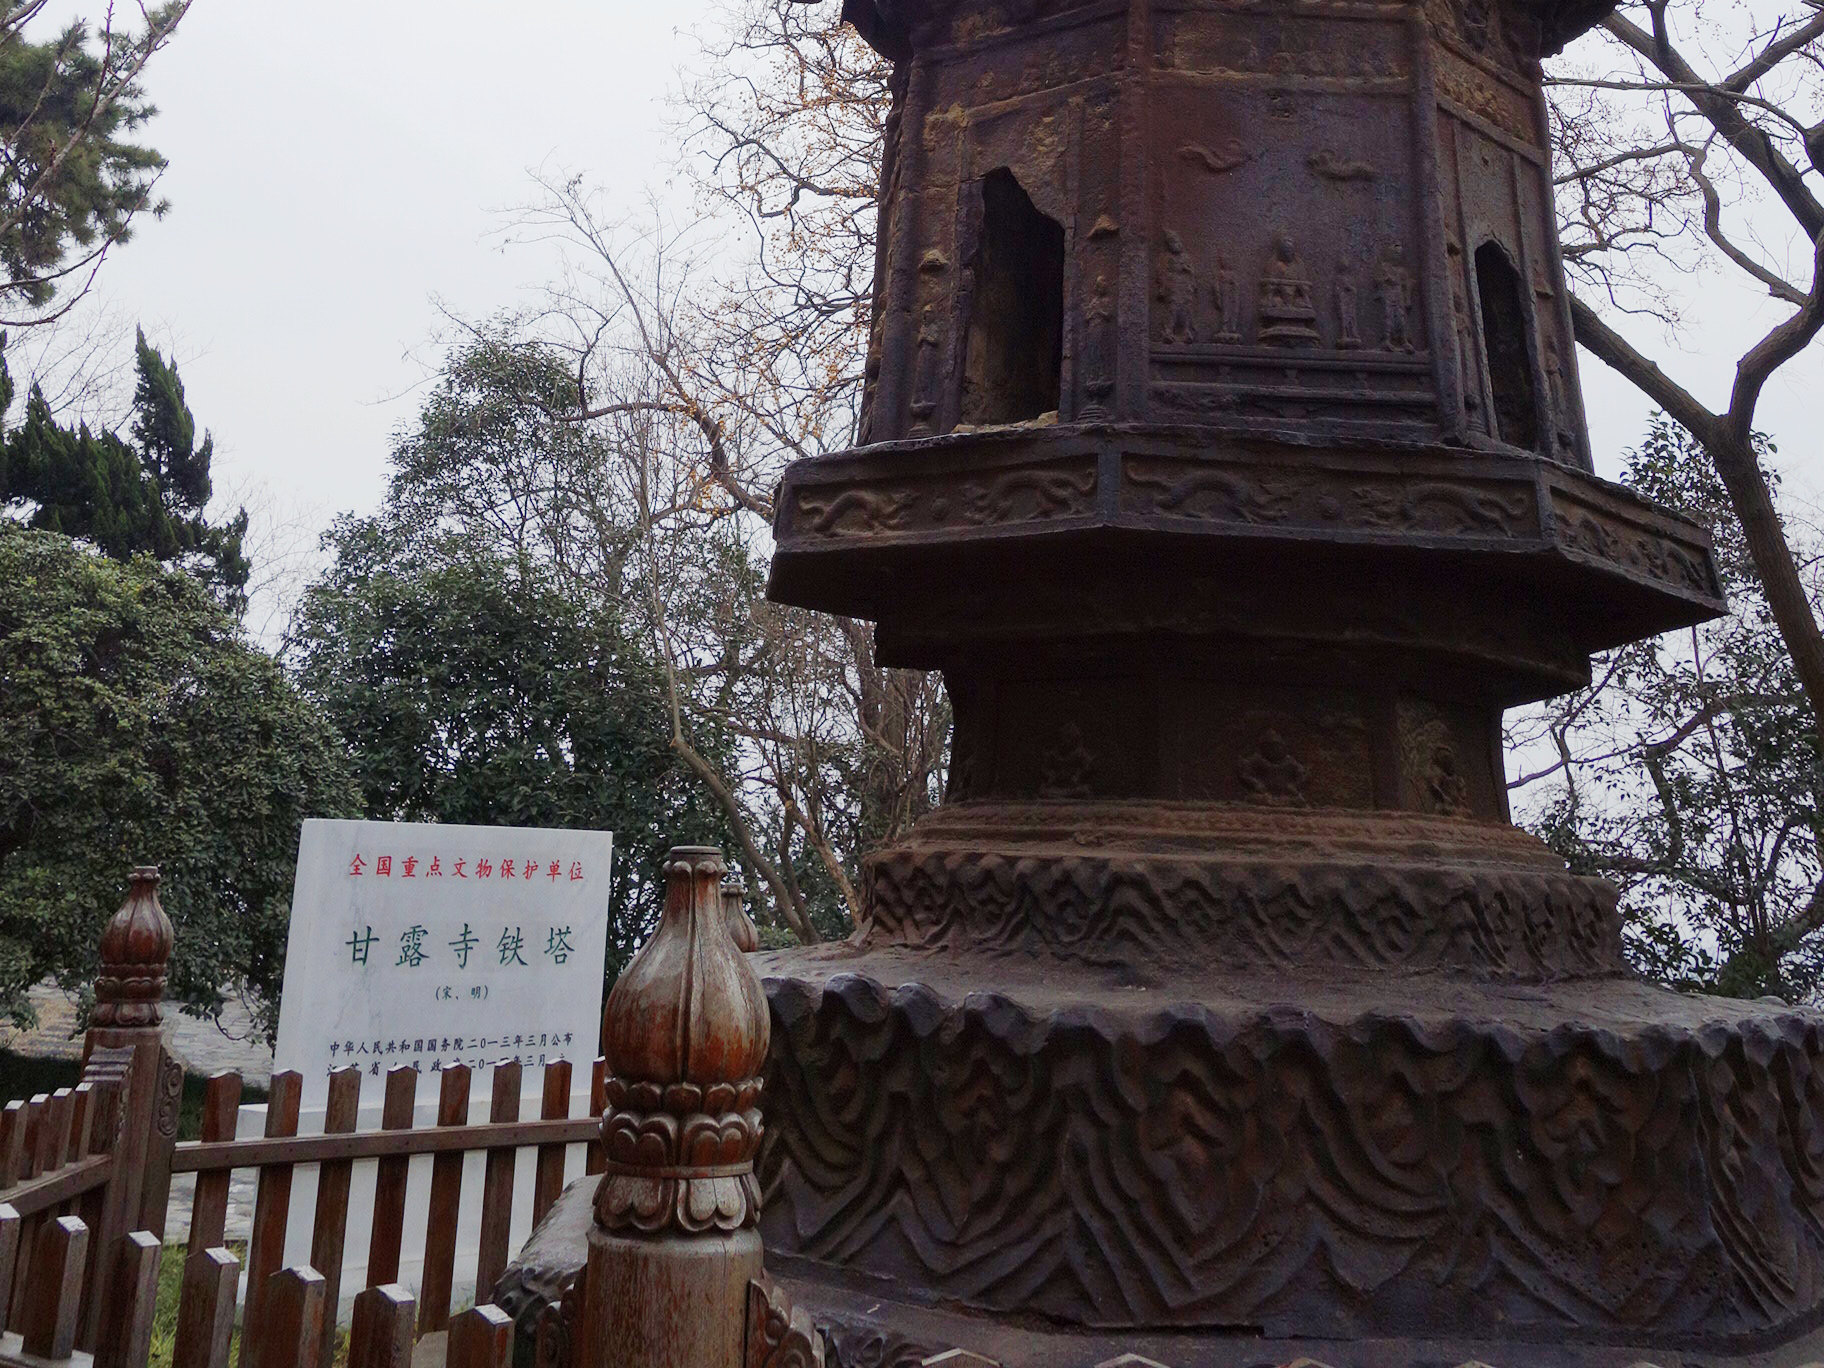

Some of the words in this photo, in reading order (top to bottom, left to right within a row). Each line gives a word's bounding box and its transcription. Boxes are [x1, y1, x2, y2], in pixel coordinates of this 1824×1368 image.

[349, 853, 584, 882] 全国重点文物保护单位
[345, 923, 575, 970] 甘露寺铁塔
